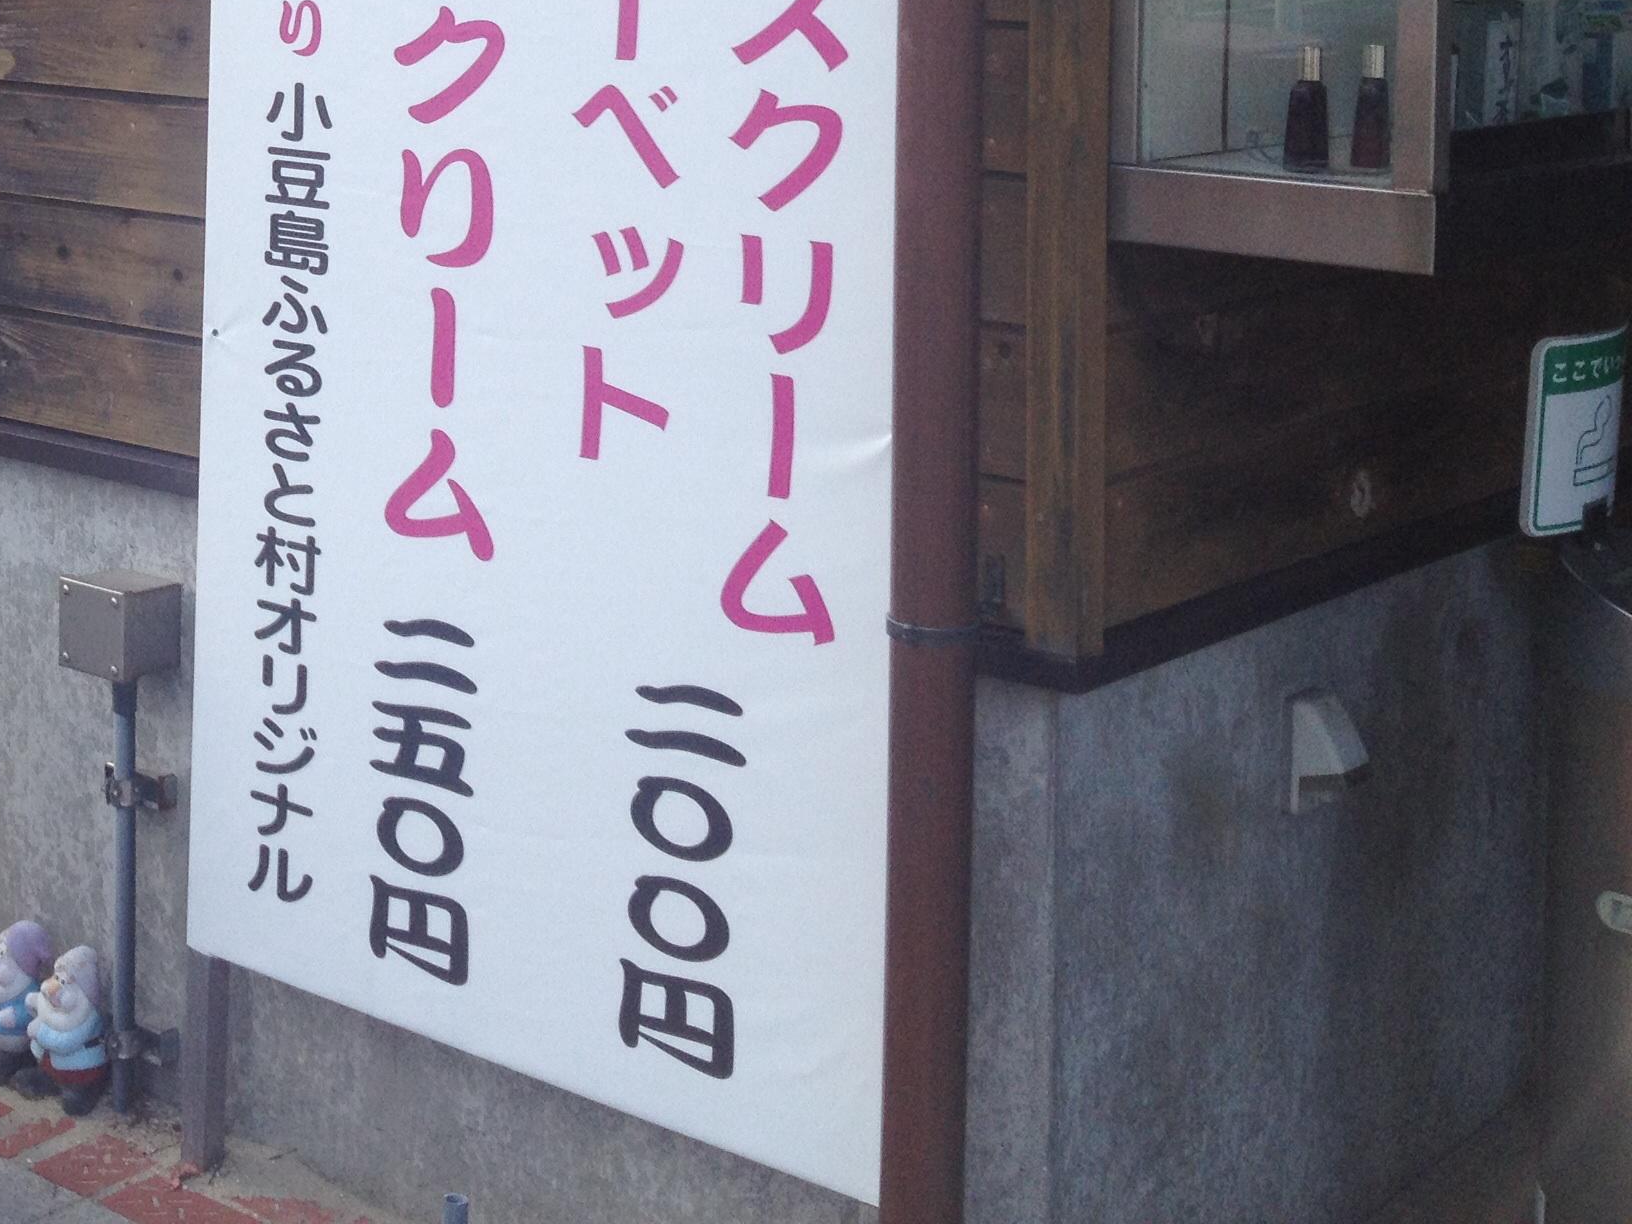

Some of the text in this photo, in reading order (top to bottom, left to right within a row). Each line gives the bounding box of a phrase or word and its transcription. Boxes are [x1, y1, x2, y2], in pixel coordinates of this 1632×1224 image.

[248, 82, 332, 903] 小豆島ふるさと村オリジナル
